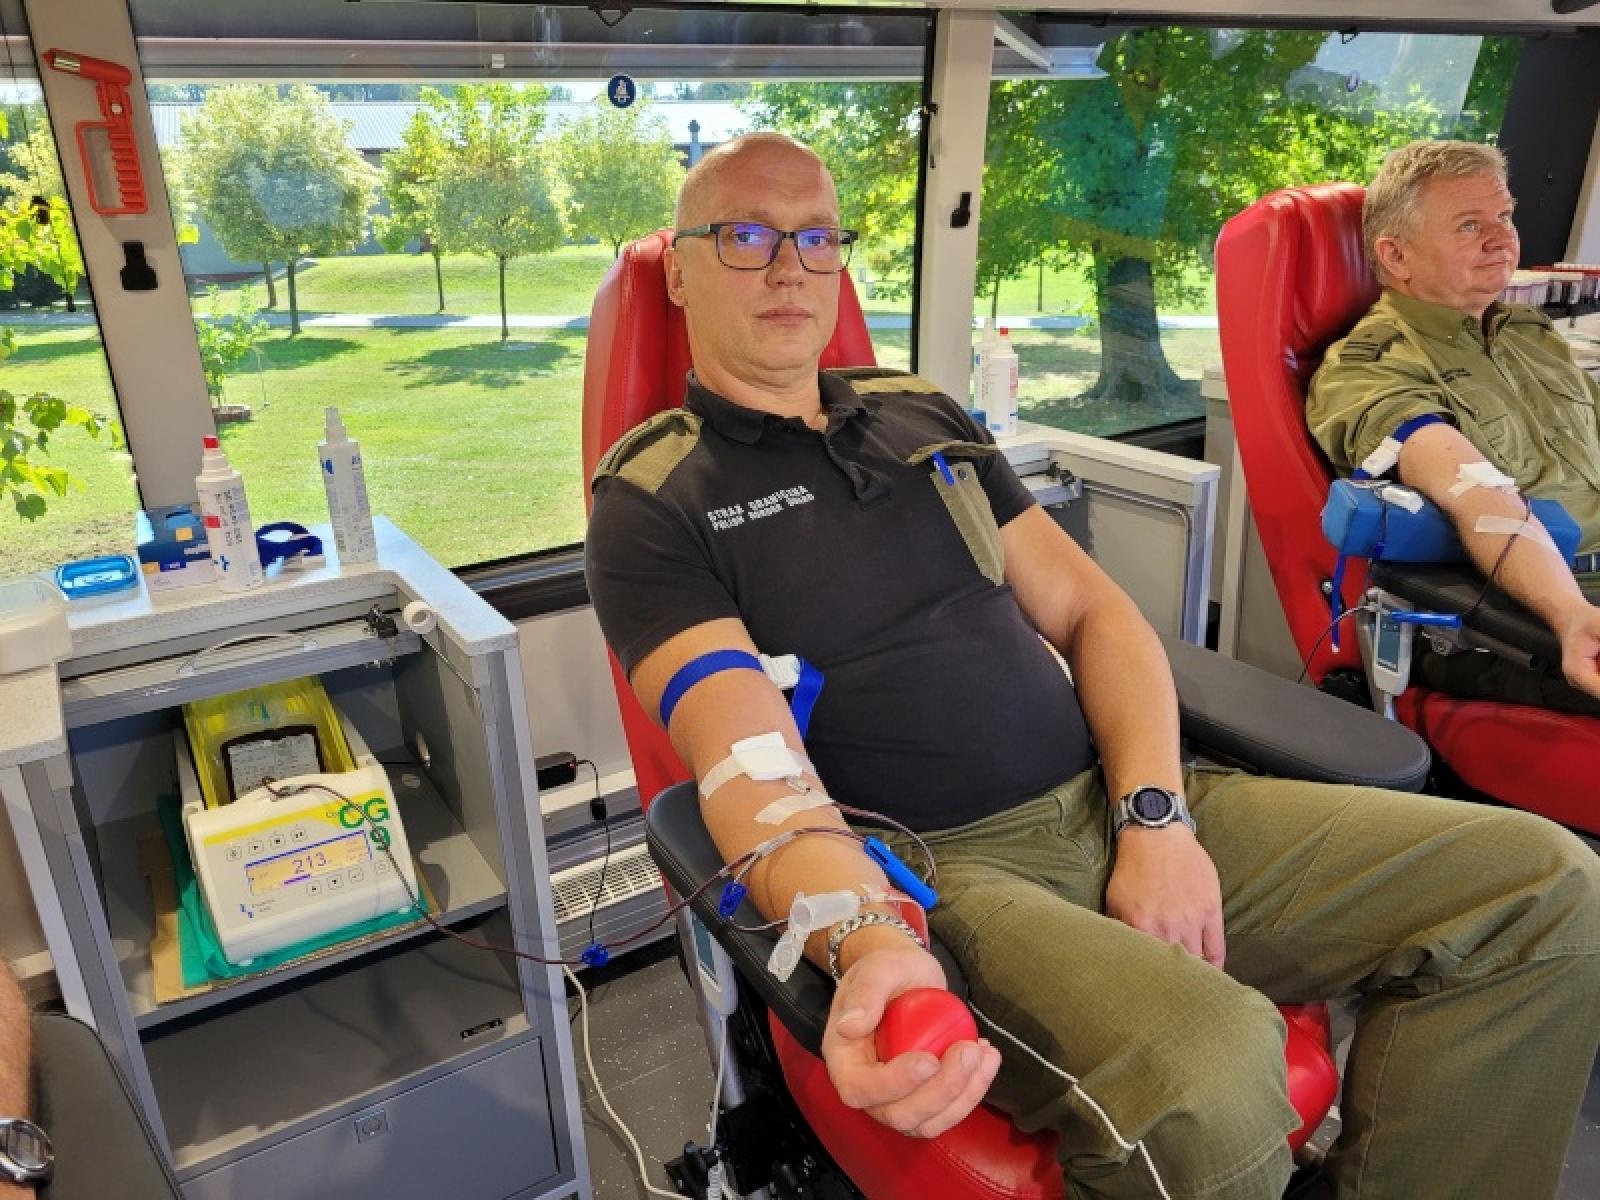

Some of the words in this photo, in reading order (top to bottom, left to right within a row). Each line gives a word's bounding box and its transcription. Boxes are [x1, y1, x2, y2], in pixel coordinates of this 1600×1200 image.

[338, 797, 390, 829] CG
[369, 826, 392, 851] 9
[293, 852, 328, 875] 213
